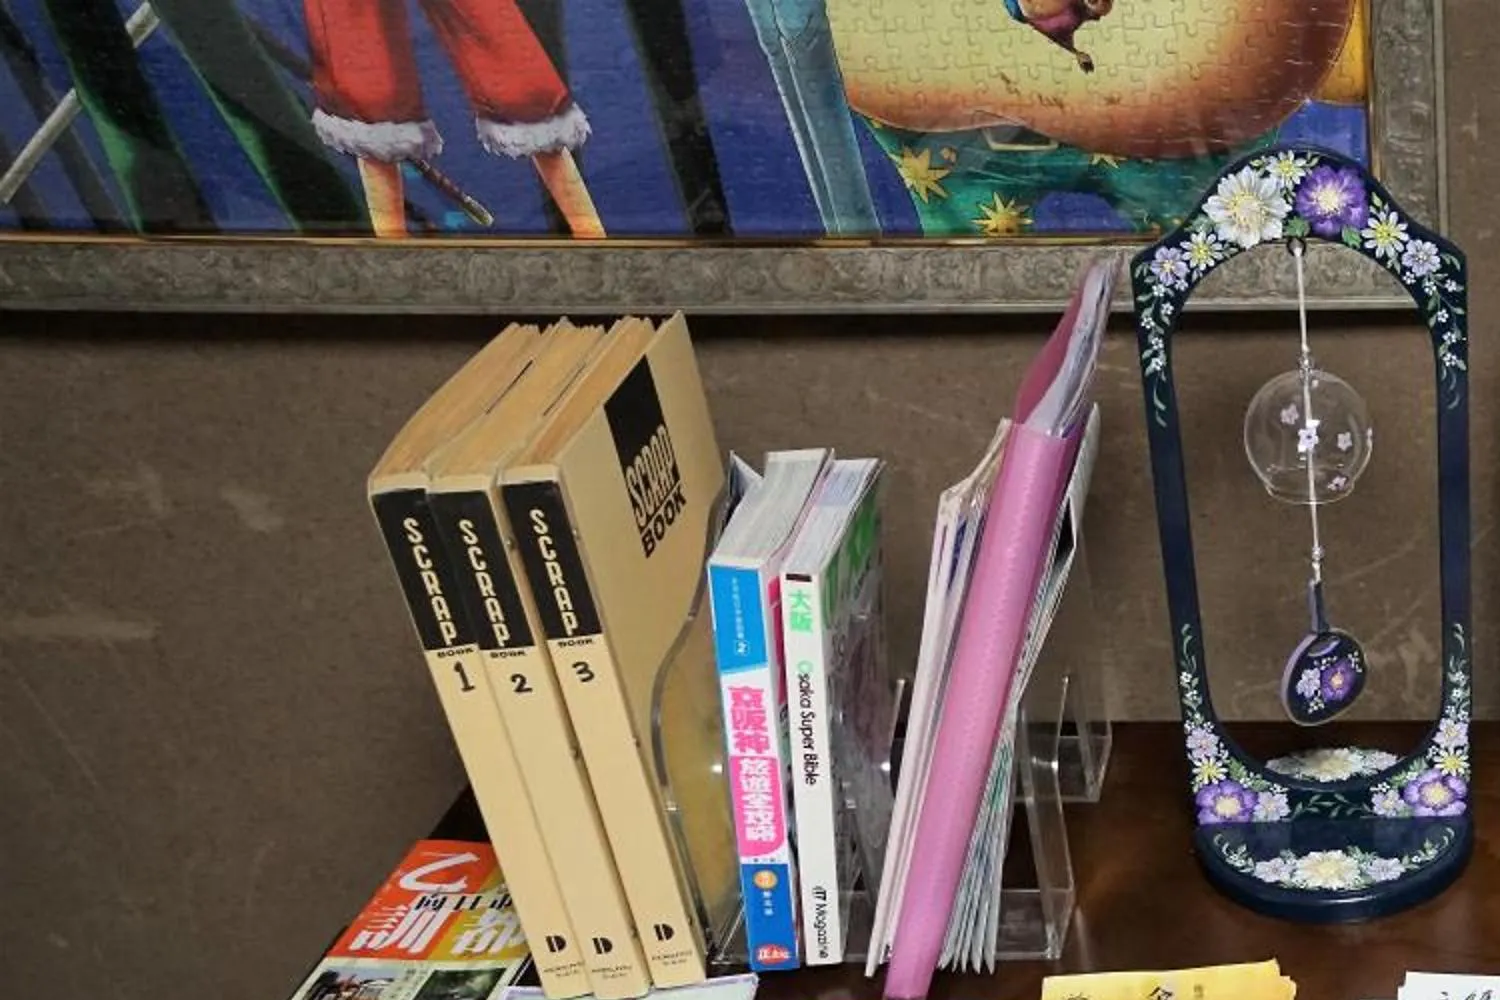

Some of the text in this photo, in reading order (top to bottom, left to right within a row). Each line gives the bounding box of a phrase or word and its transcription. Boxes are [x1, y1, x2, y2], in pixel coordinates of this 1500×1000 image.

[625, 424, 675, 528] SCRAP
[642, 484, 687, 558] BOOK
[403, 517, 457, 646] SCRAP
[459, 519, 511, 647] SCRAP
[529, 509, 579, 636] SCRAP
[453, 662, 476, 692] 1
[510, 674, 533, 693] 2
[572, 661, 595, 683] 3
[797, 660, 820, 787] Osaka Super Bible
